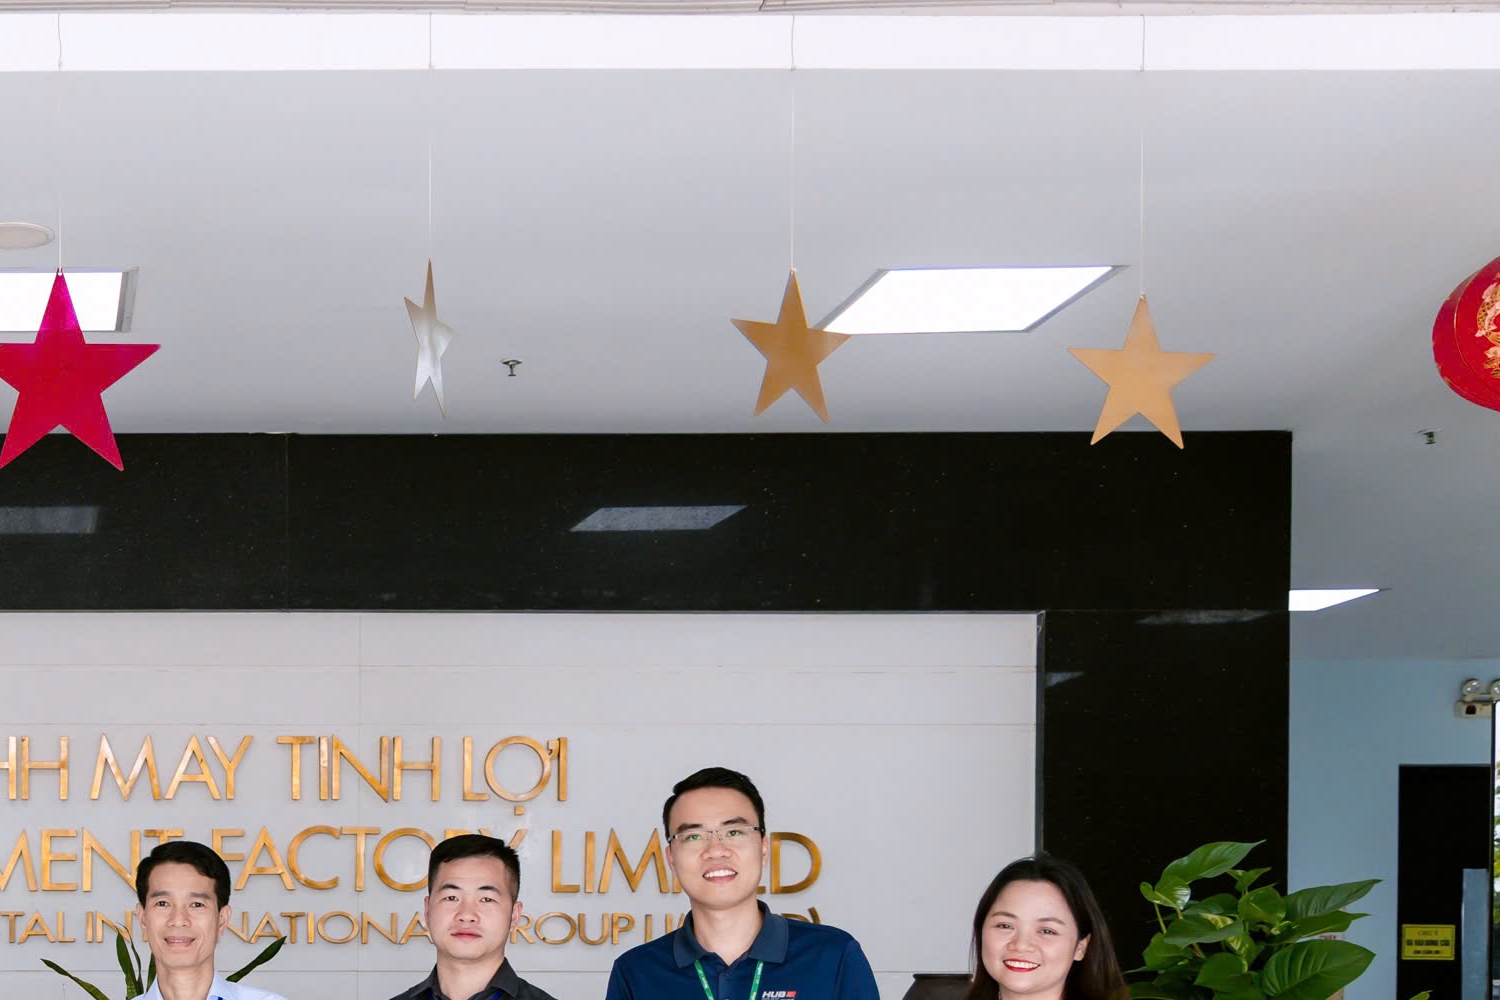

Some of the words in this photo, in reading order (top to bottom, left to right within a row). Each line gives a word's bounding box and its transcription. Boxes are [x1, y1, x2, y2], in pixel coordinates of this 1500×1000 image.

[90, 732, 254, 801] MAY
[276, 735, 442, 802] TINH
[462, 734, 568, 816] LỢI
[510, 911, 636, 945] ROUP
